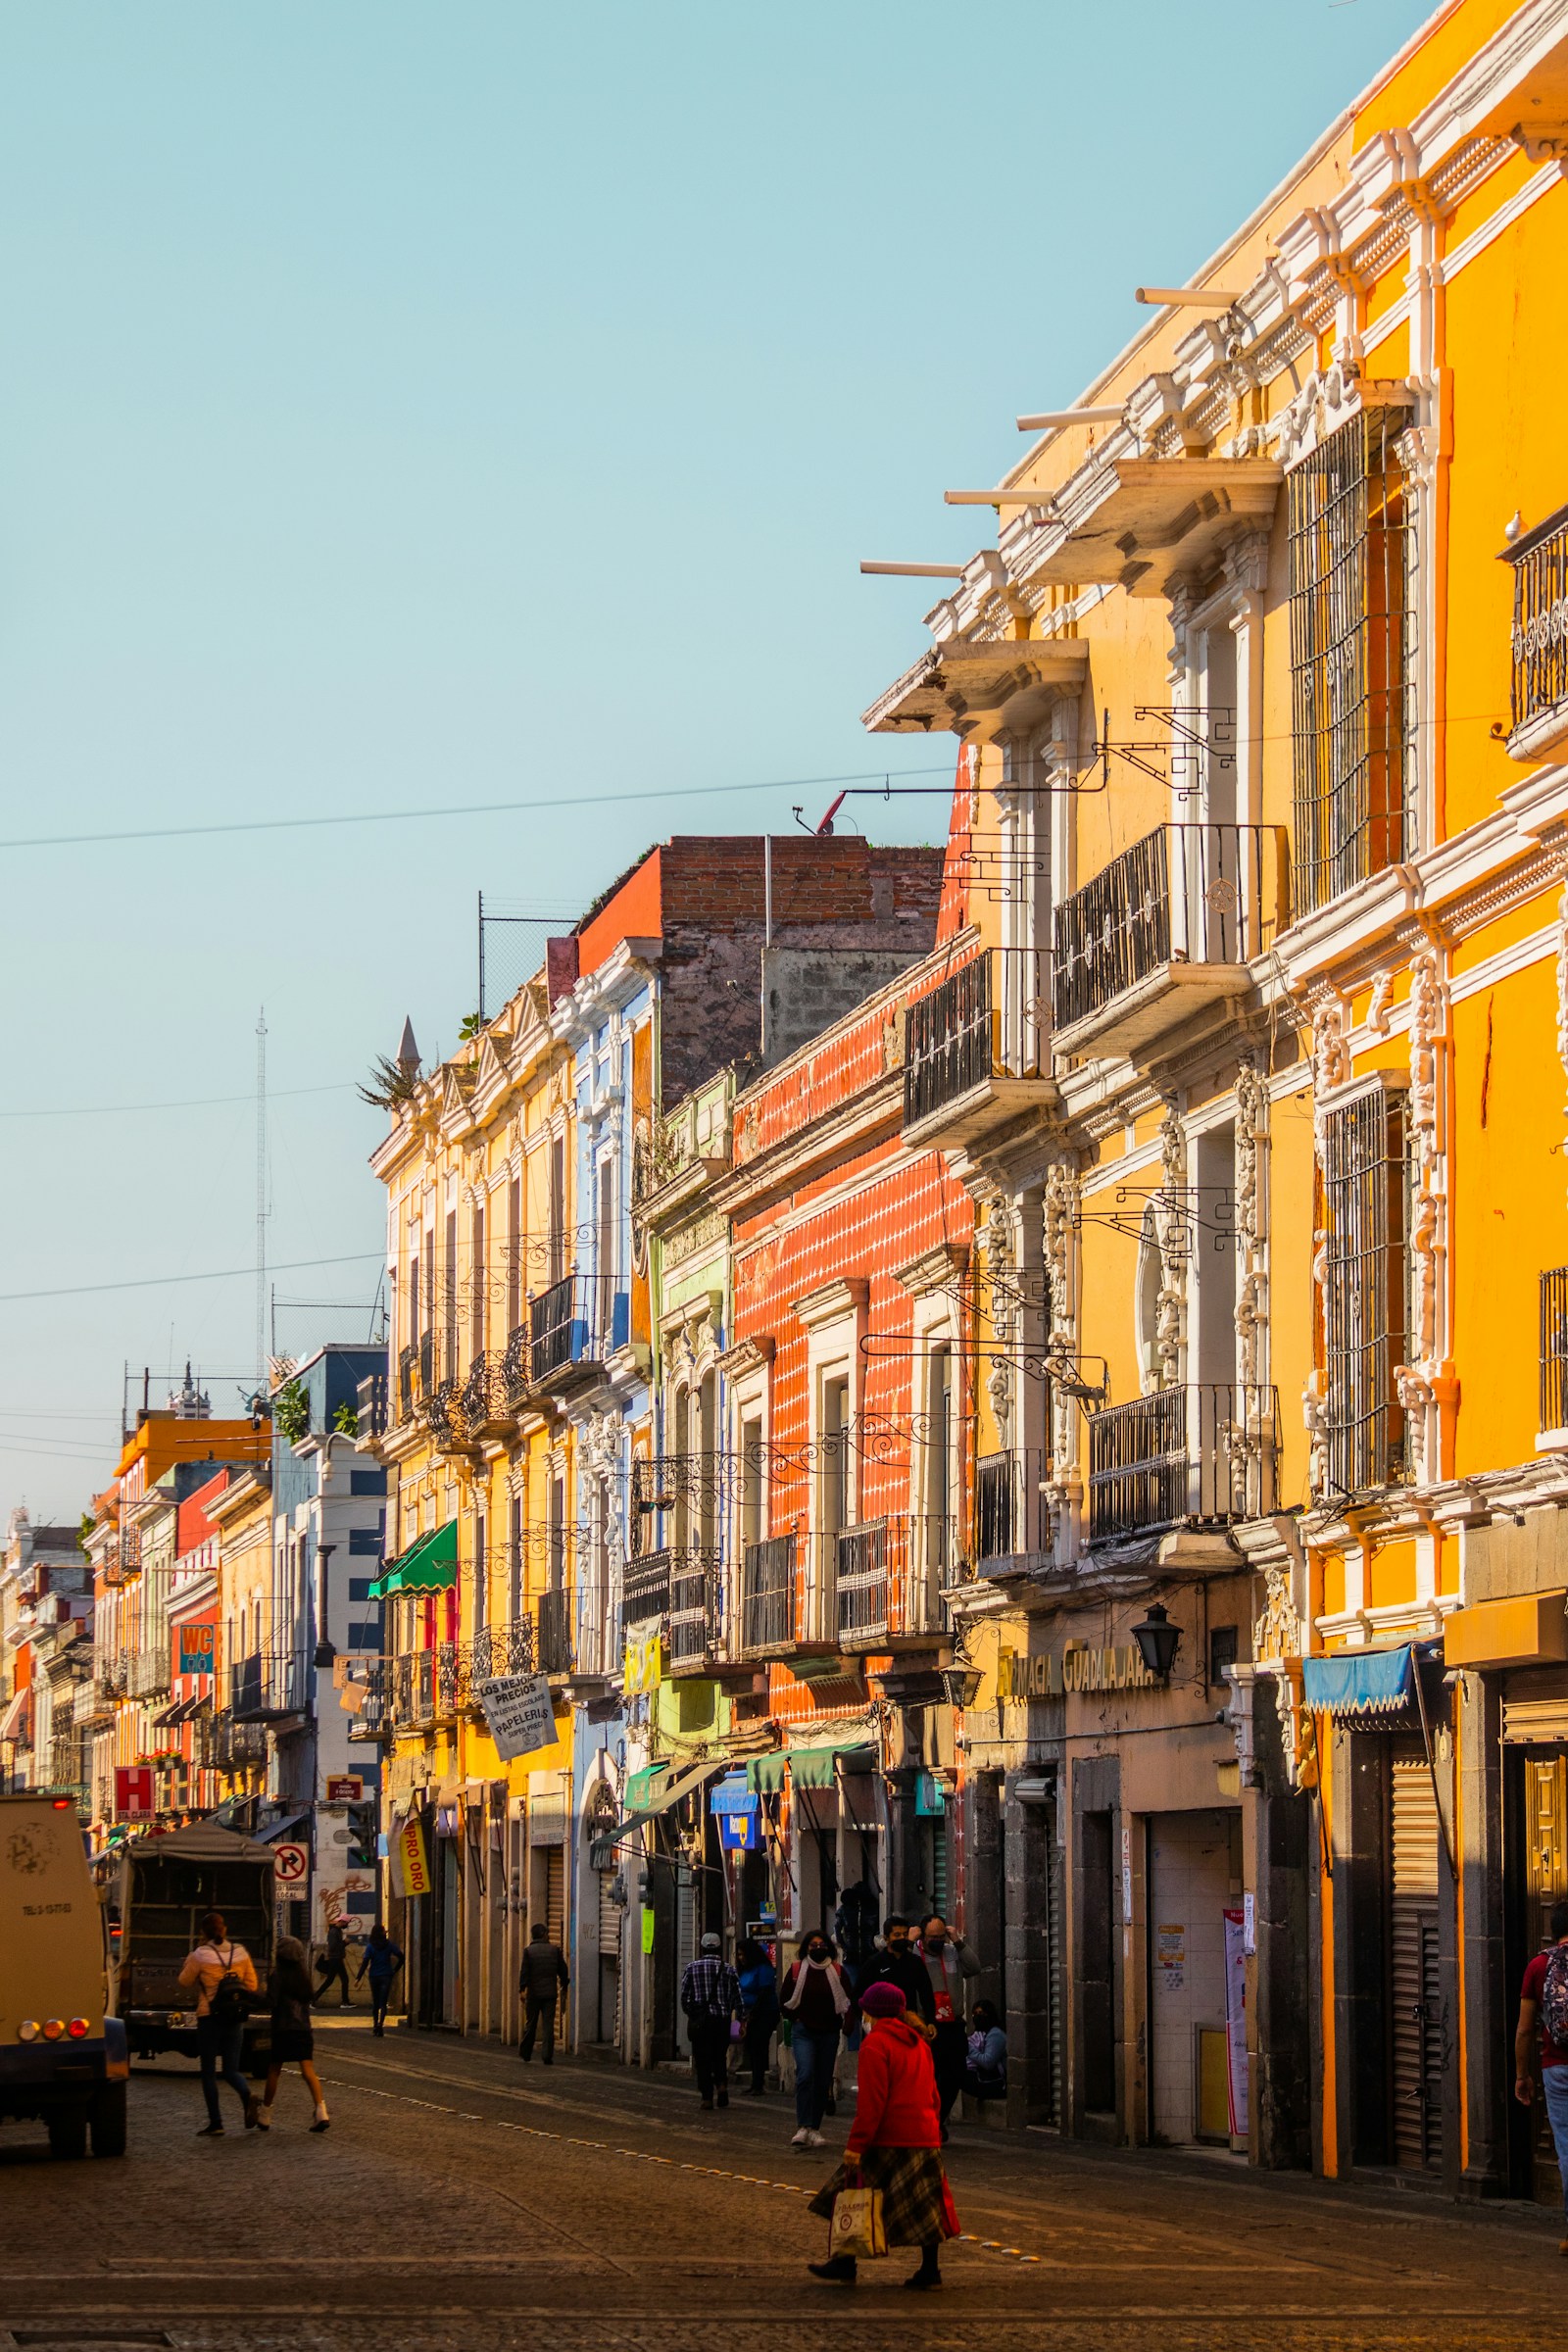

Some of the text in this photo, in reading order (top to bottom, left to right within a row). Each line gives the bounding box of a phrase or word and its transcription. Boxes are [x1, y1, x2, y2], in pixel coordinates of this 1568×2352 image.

[182, 1626, 214, 1655] WC
[480, 1684, 500, 1697] LOS
[495, 1683, 537, 1705] PRECIOS
[495, 1708, 549, 1736] PAPELERIS
[499, 1704, 518, 1716] LISTAS
[508, 1728, 527, 1739] SUPER
[117, 1770, 151, 1811] H
[410, 1862, 425, 1891] ORO
